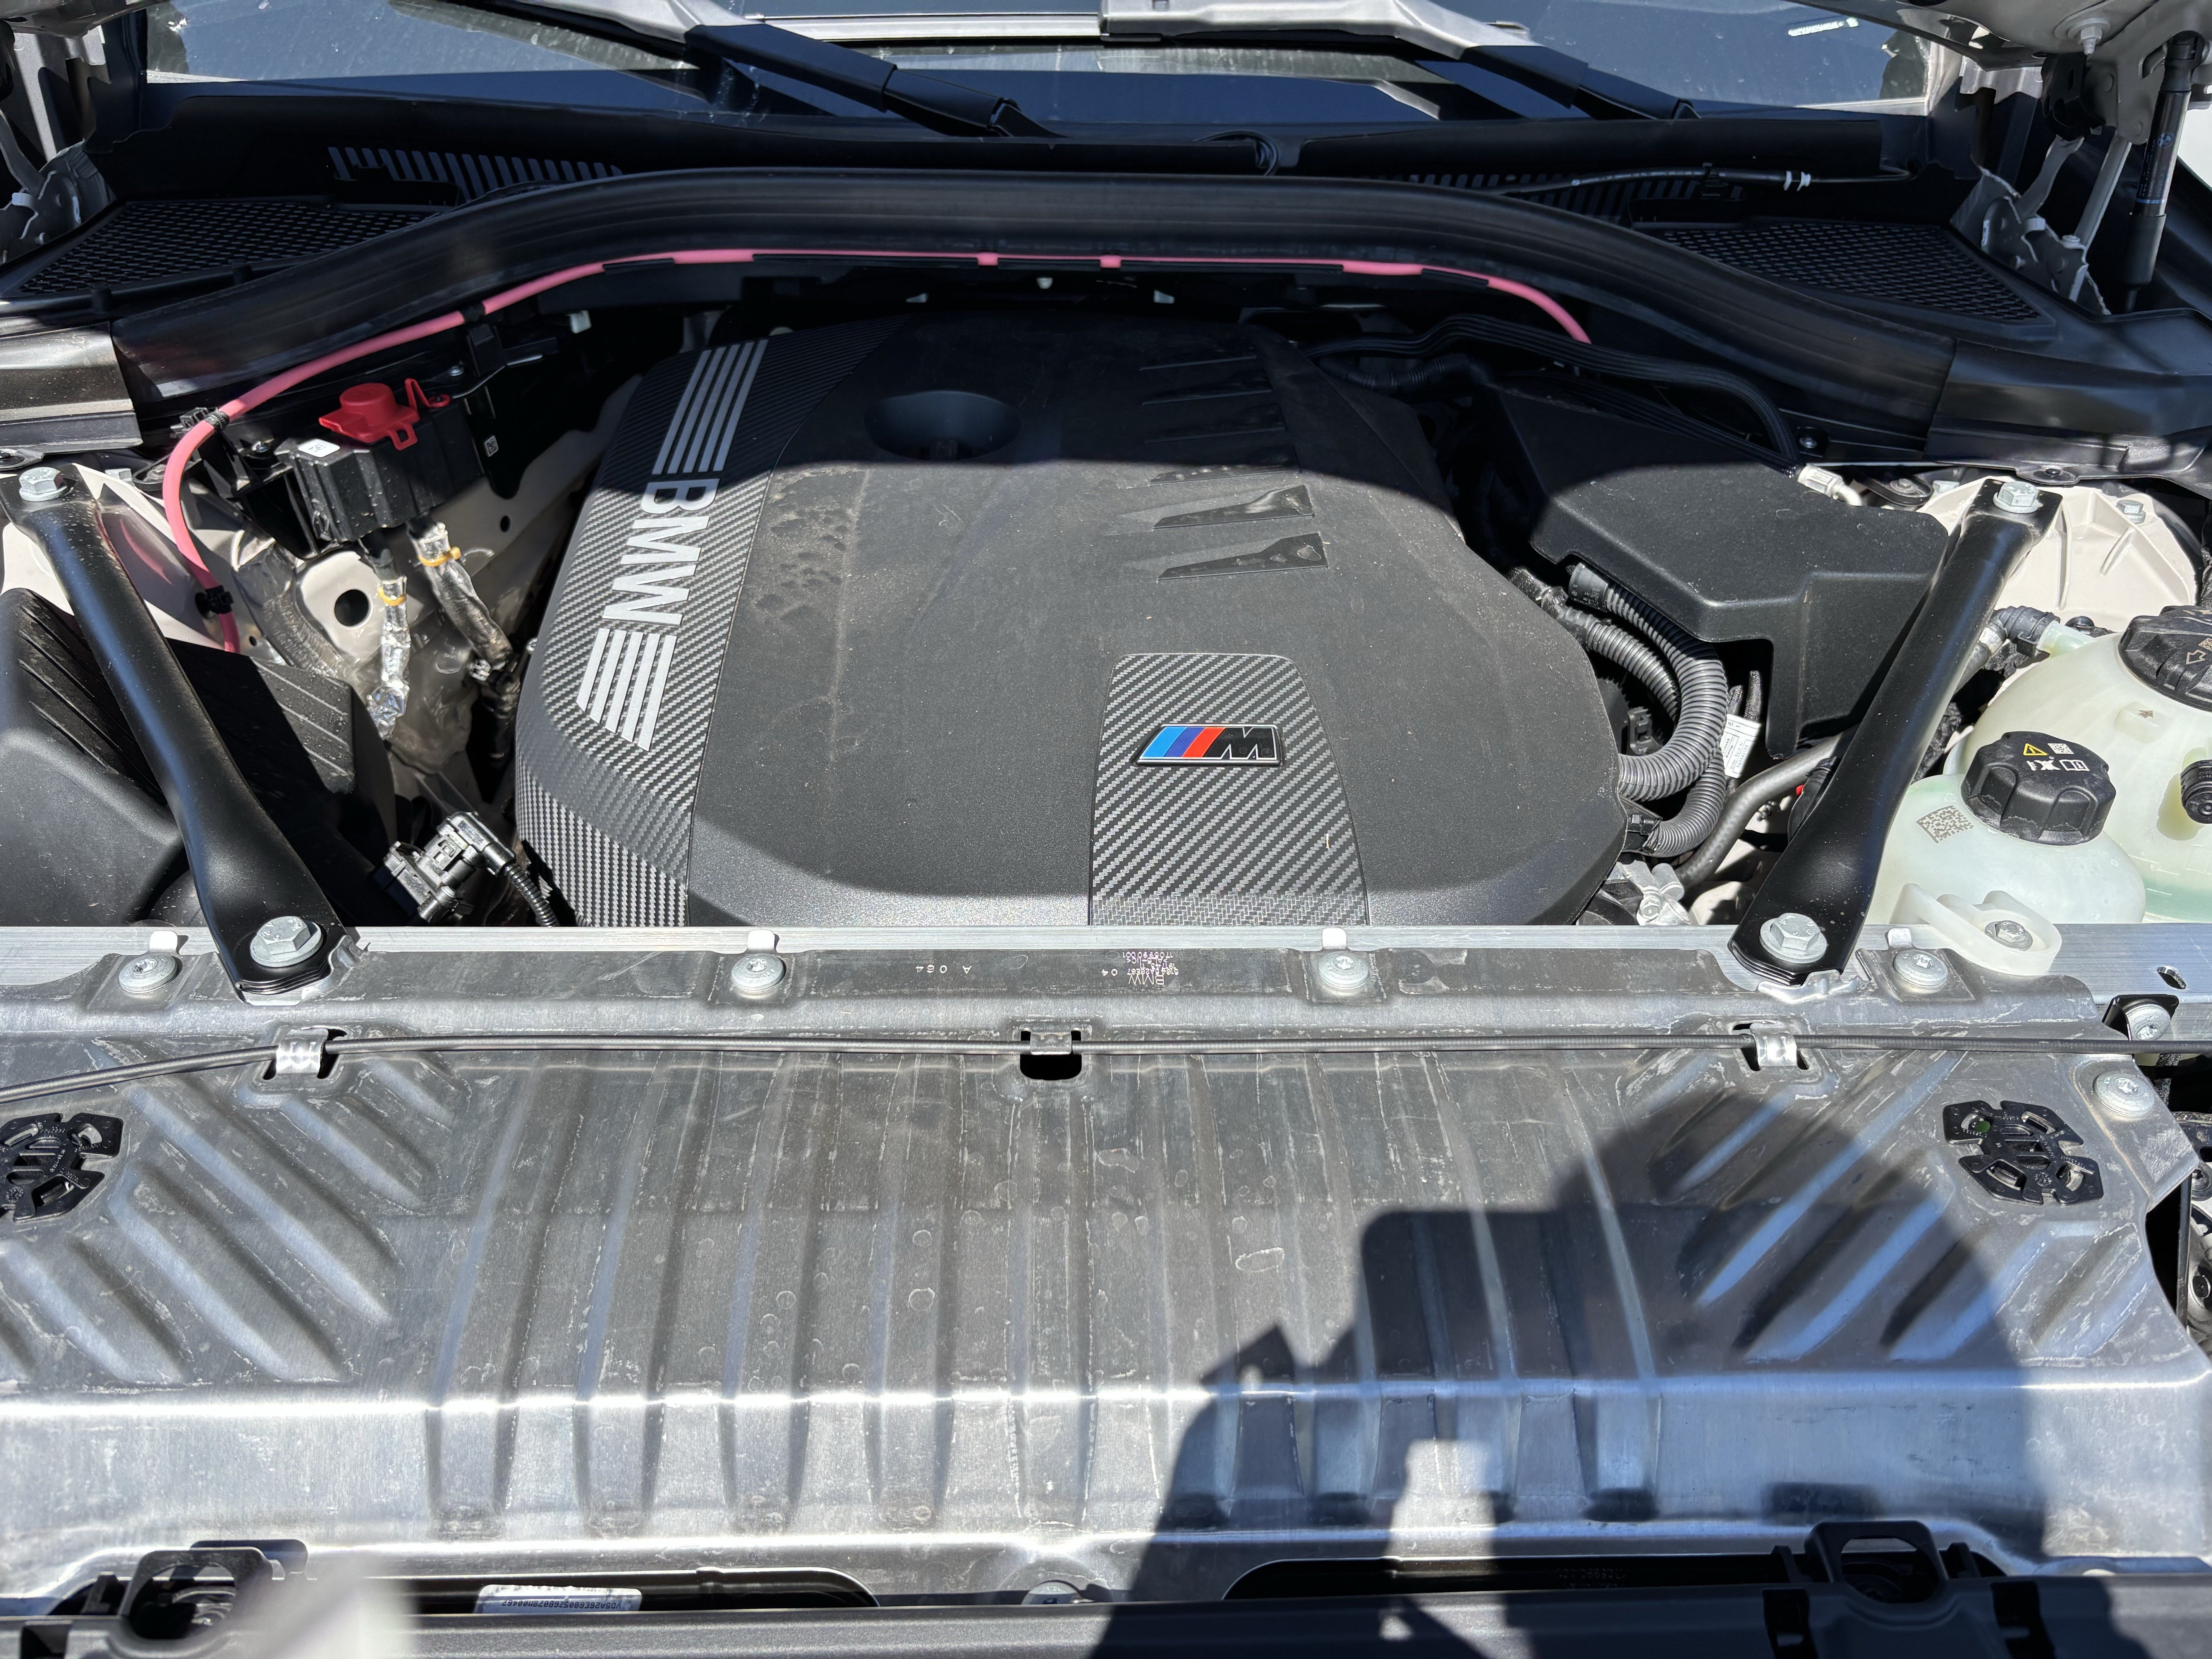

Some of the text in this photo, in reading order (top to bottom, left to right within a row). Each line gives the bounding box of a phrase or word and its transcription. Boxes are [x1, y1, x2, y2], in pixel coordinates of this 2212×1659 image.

[603, 478, 721, 626] BMW
[962, 965, 972, 974] A
[1128, 975, 1164, 985] BMW
